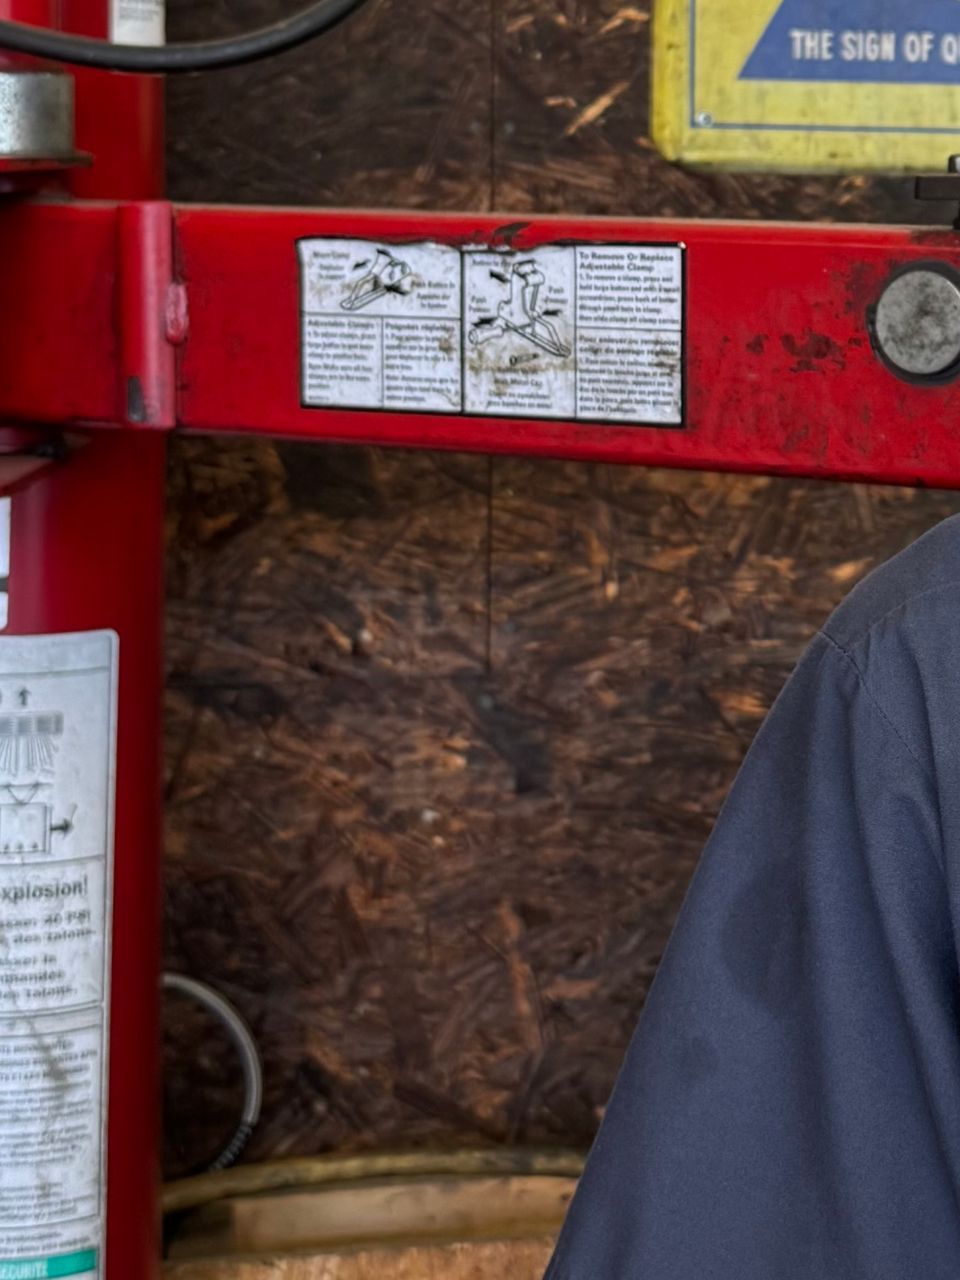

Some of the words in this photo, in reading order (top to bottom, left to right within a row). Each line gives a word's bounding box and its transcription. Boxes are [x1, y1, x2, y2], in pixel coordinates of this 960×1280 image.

[790, 30, 833, 61] THE
[841, 31, 895, 62] SIGN
[905, 32, 934, 62] OF
